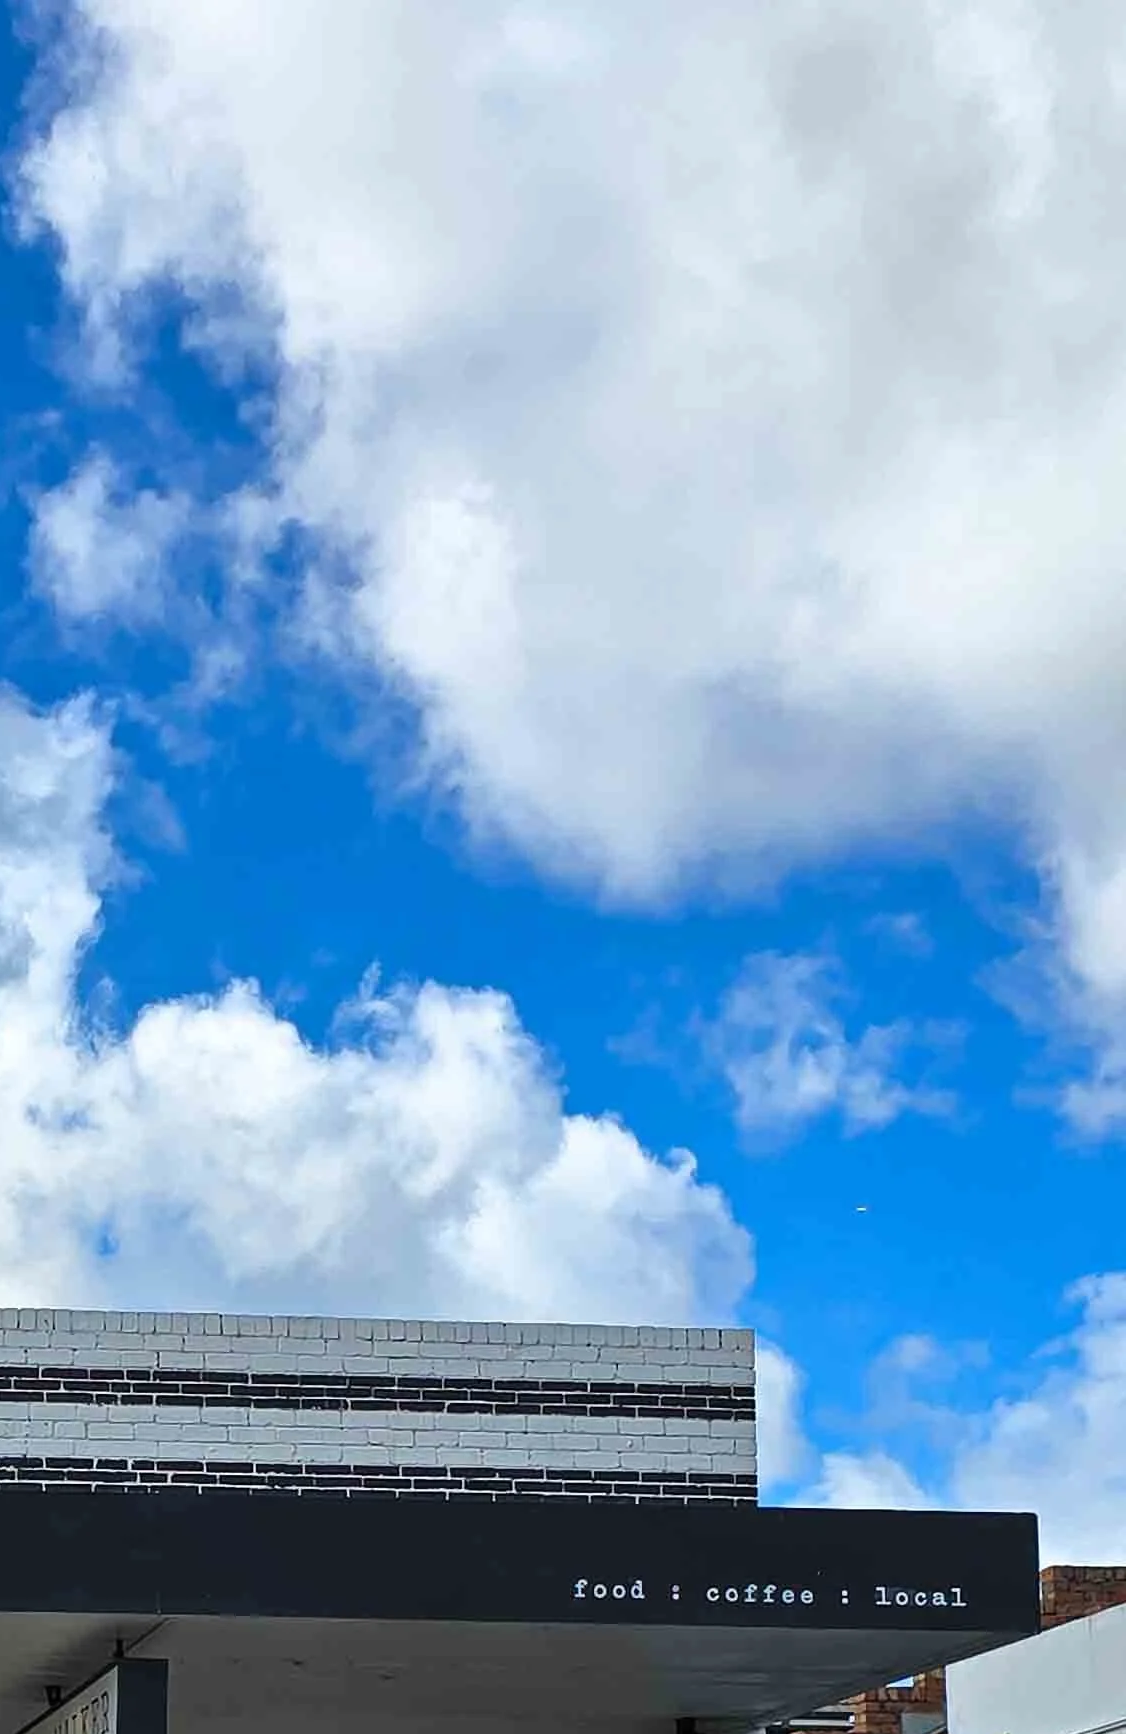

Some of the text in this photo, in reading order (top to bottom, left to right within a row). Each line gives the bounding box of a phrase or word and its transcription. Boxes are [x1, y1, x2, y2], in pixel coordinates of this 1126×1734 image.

[574, 1580, 645, 1600] food
[706, 1584, 815, 1604] coffee
[875, 1586, 967, 1607] local
